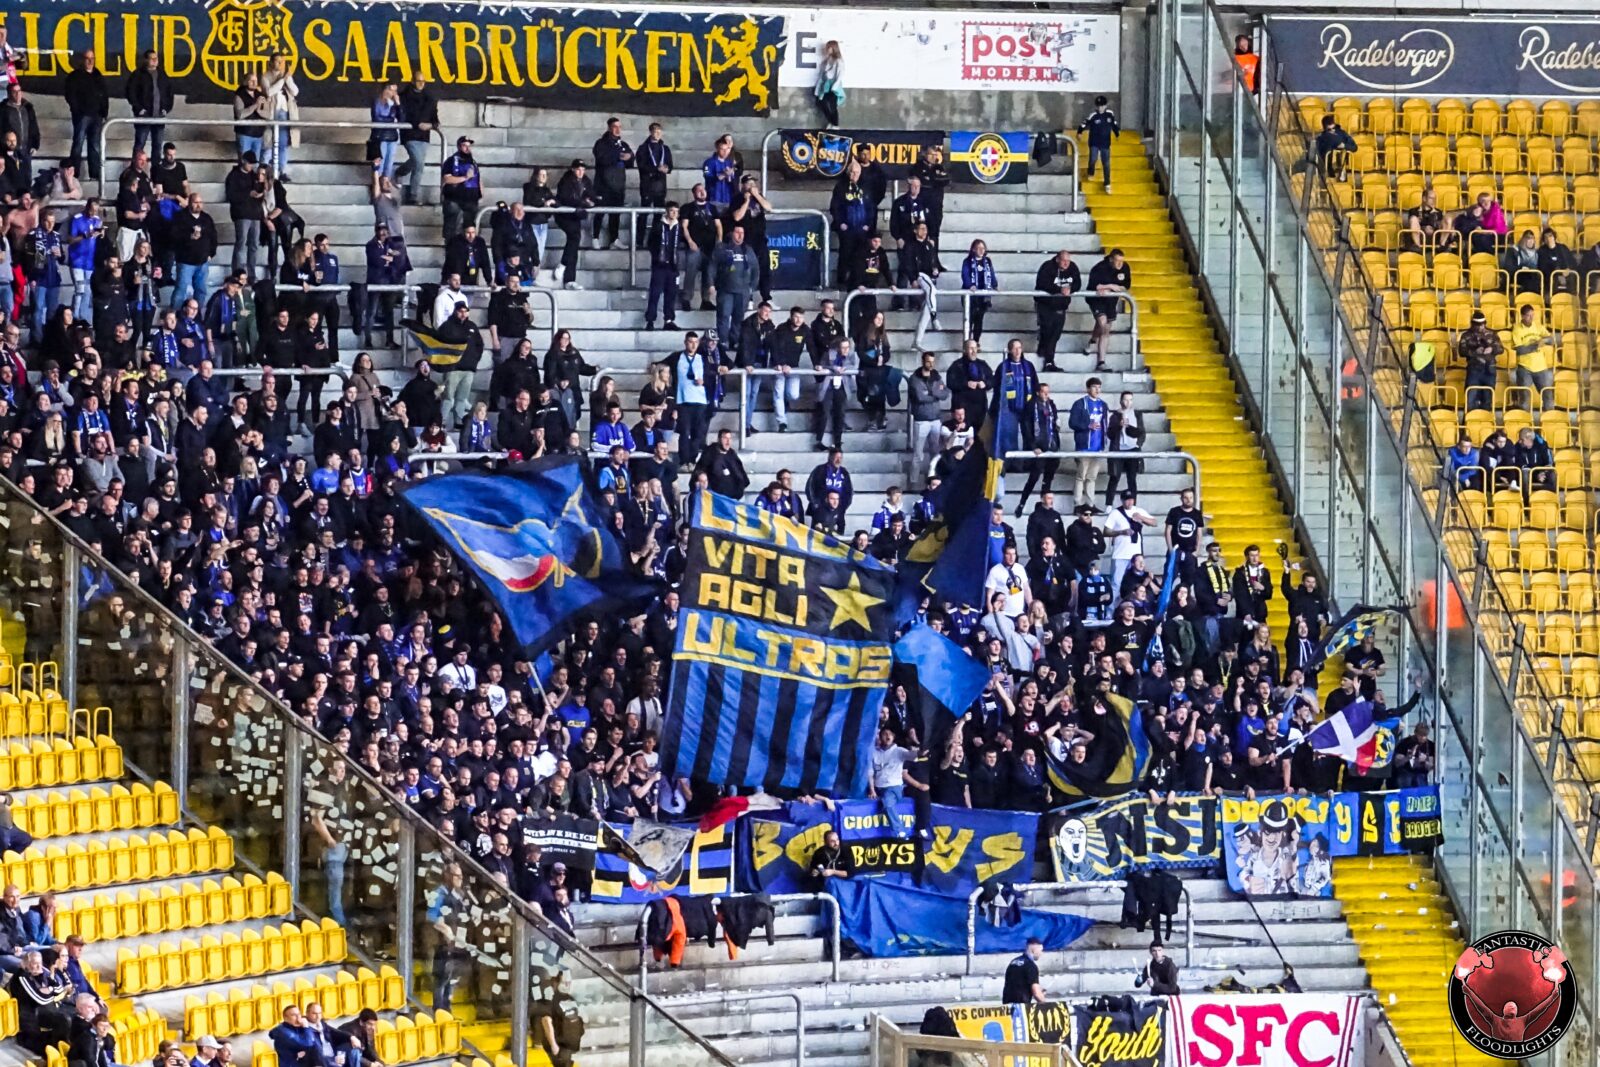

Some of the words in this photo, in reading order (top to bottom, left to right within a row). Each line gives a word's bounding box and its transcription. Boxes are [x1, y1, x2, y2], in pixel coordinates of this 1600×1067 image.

[302, 17, 713, 94] SAARBRÜCKEN
[971, 66, 1052, 79] MODERN
[972, 34, 1052, 62] post
[1317, 22, 1448, 77] Radeberger
[703, 536, 806, 590] VITA
[698, 572, 808, 627] AGLI
[683, 612, 893, 681] ULTRAS
[1404, 819, 1442, 839] BADGER
[1080, 1005, 1163, 1063] Youth
[1188, 1003, 1341, 1067] SFC
